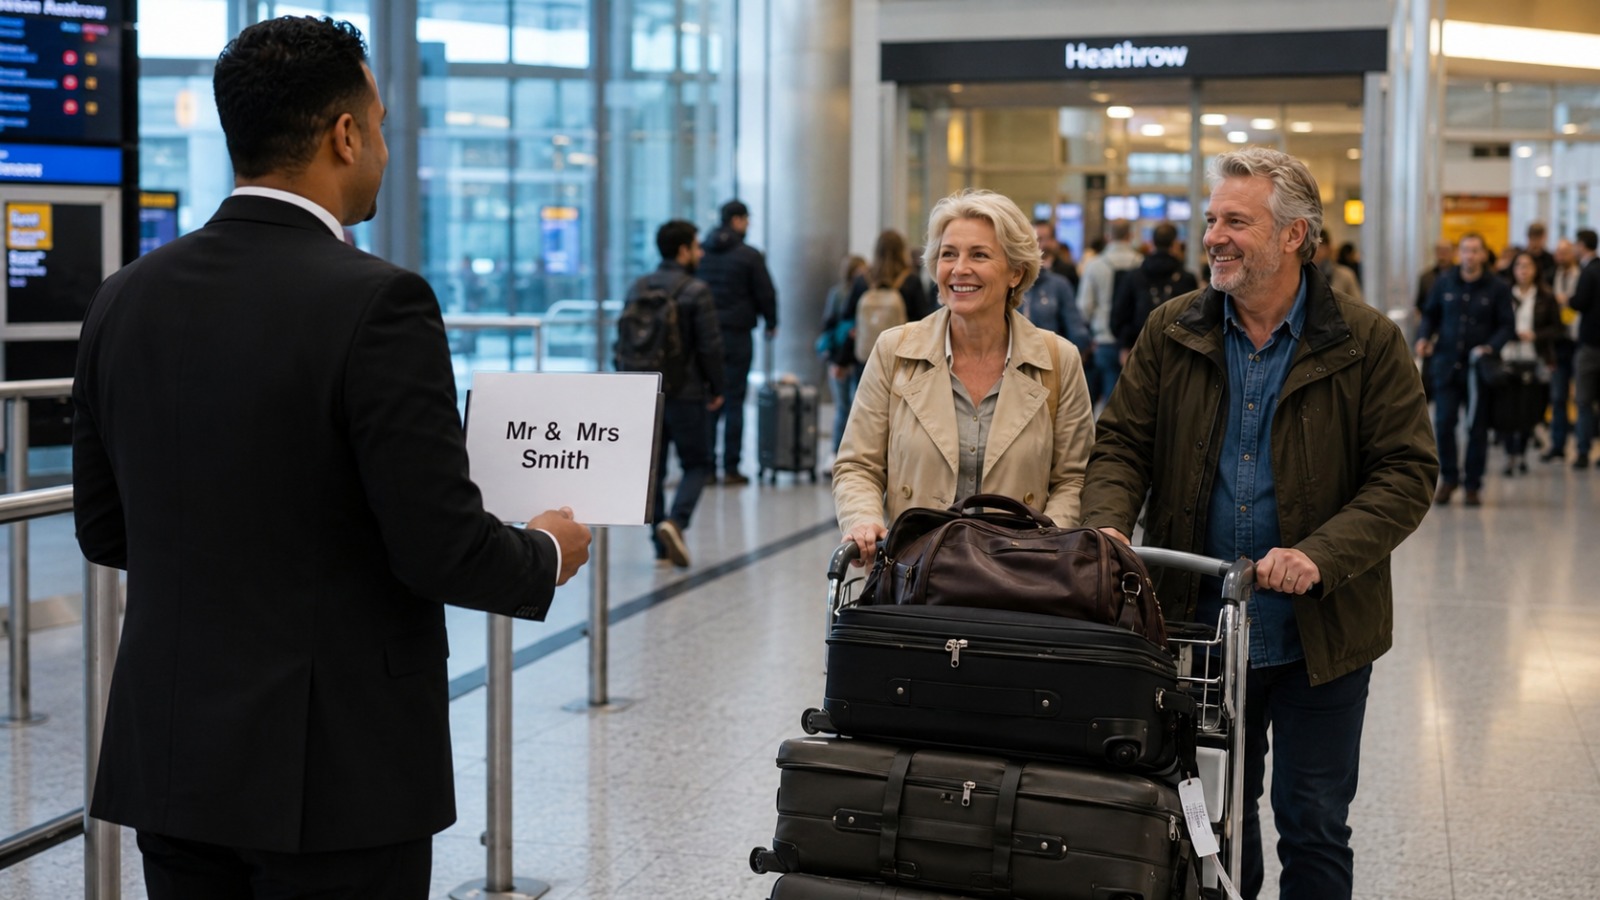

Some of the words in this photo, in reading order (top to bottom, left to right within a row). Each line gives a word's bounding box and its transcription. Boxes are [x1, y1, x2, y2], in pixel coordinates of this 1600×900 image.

[1065, 40, 1189, 69] Heathrow
[506, 421, 537, 440] Mr
[544, 421, 561, 441] &
[576, 422, 620, 442] Mrs
[521, 448, 590, 470] Smith
